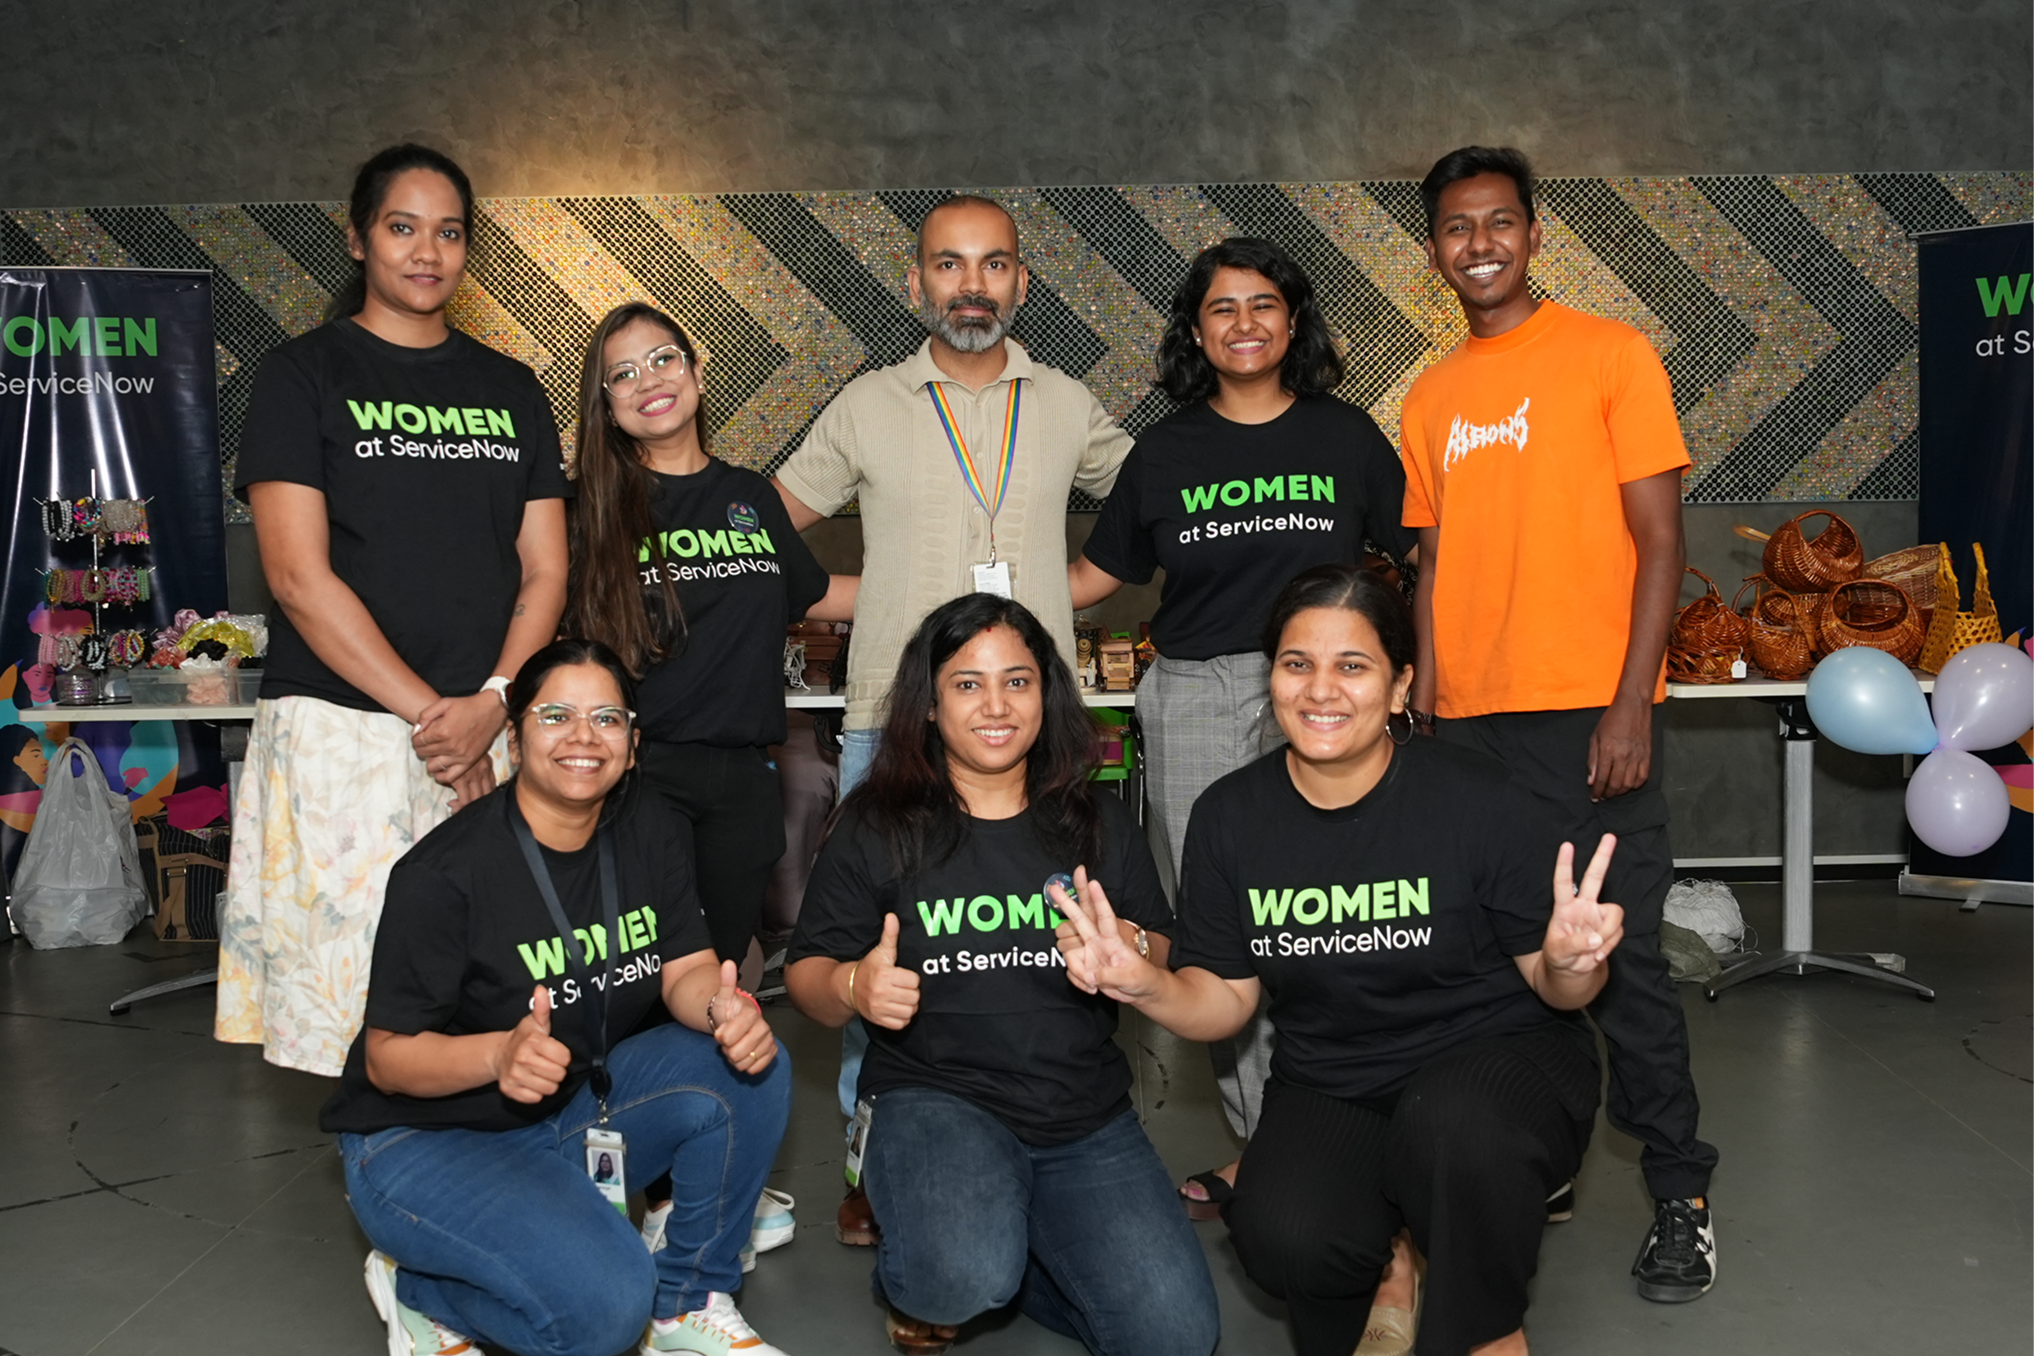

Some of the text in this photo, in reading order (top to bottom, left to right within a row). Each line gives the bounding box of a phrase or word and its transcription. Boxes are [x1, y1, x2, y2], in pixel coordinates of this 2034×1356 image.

[1975, 273, 2034, 317] W
[0, 316, 158, 357] OMEN
[1975, 330, 2034, 357] at S
[346, 399, 516, 438] WOMEN
[355, 434, 520, 462] at ServiceNow
[1180, 474, 1335, 514] WOMEN
[1179, 513, 1334, 544] at ServiceNow
[666, 557, 781, 582] ServiceNow
[1248, 877, 1430, 926] WOMEN
[1250, 925, 1432, 957] at ServiceNow
[923, 954, 951, 975] at
